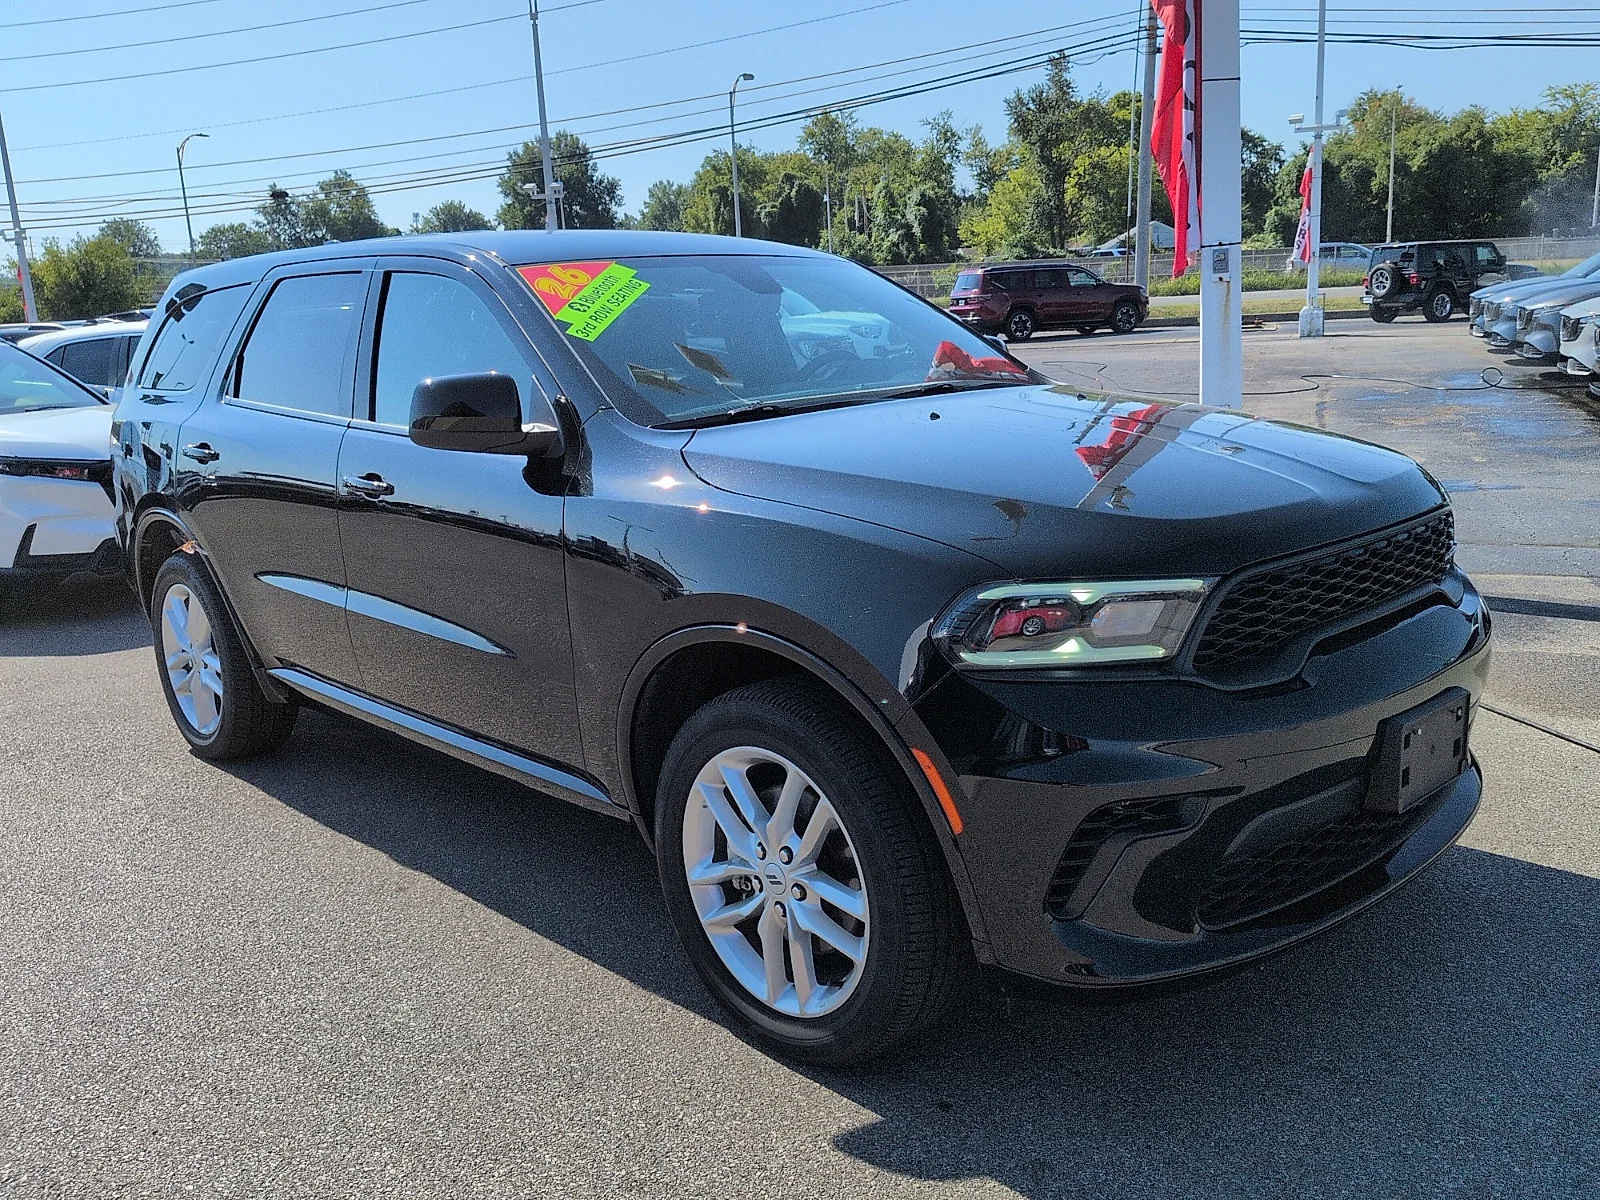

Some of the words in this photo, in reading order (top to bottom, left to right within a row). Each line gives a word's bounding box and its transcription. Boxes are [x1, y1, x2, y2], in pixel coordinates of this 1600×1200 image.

[535, 265, 592, 299] 26
[579, 275, 621, 305] Bluetooth
[575, 321, 597, 338] 3rd
[590, 304, 614, 324] ROW
[607, 279, 642, 307] SEATING
